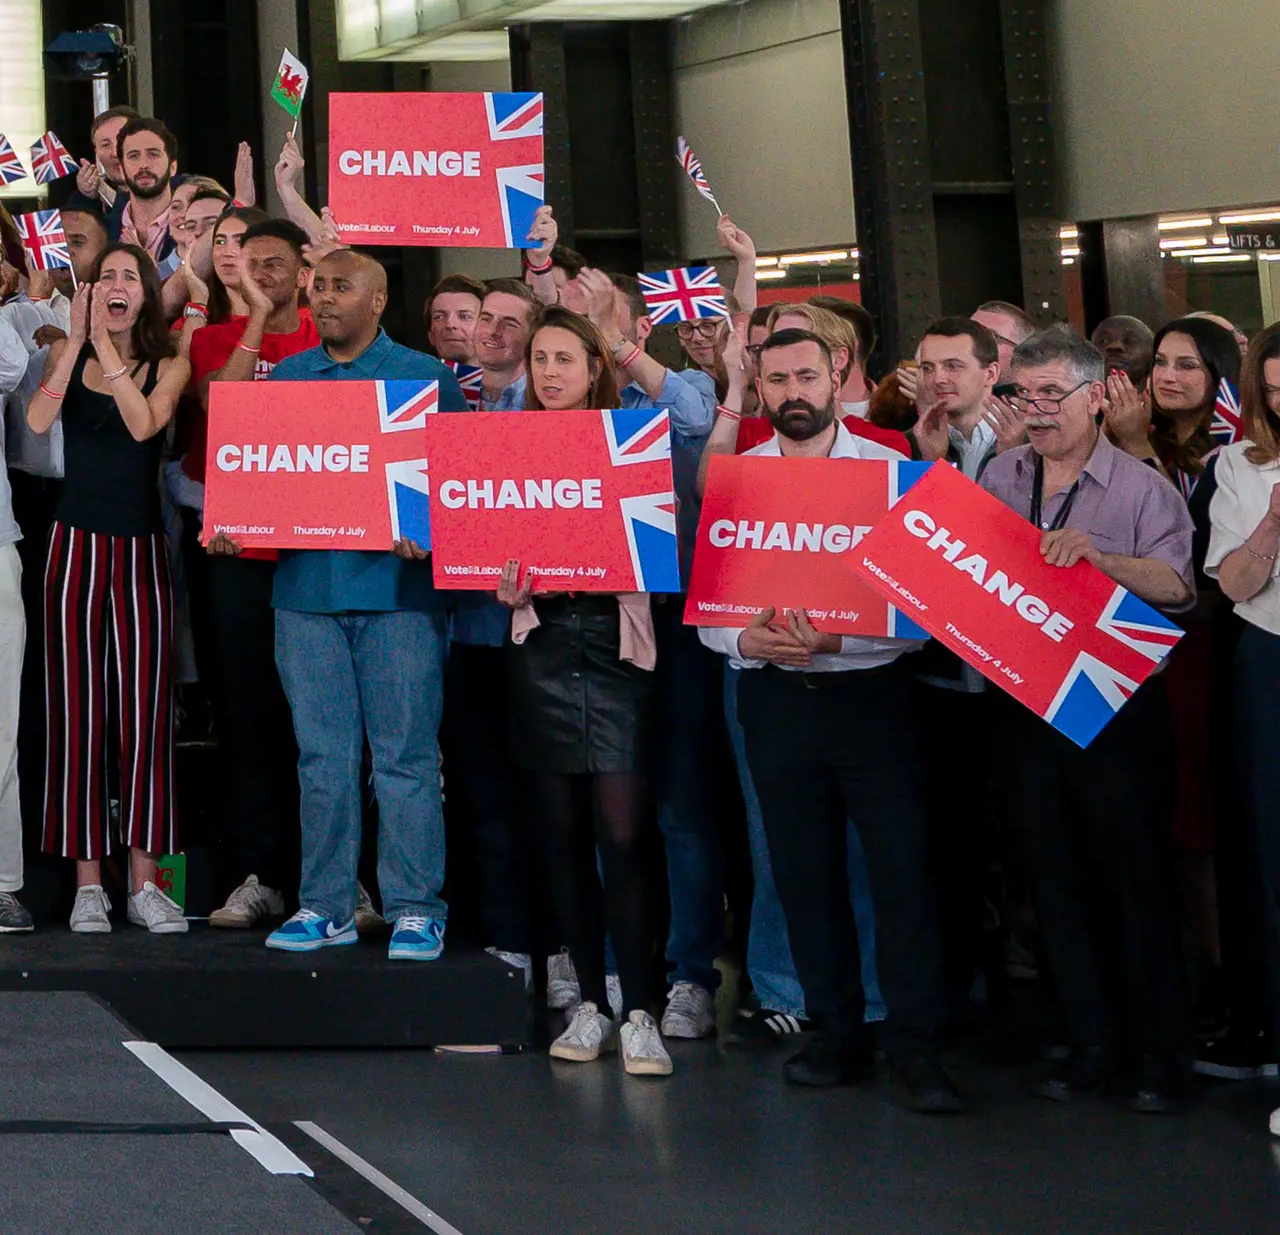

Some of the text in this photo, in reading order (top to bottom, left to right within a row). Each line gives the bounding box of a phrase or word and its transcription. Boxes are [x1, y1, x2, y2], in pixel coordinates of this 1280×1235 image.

[338, 149, 481, 177] CHANGE
[337, 223, 396, 233] Vote Labour
[412, 224, 481, 237] Thursday 4 July
[1230, 233, 1261, 248] LIFTS
[216, 444, 370, 473] CHANGE
[439, 478, 603, 510] CHANGE
[213, 524, 275, 535] Vote Labour
[292, 525, 366, 539] Thursday 4 July
[443, 565, 504, 576] Vote Labo
[528, 565, 607, 579] Thursday 4 July
[903, 509, 1075, 643] CHANGE
[862, 556, 929, 611] Vote Labour
[697, 601, 764, 616] Vote Labour
[782, 607, 859, 622] Tday 4 July
[944, 621, 1024, 685] Thursday 4 July
